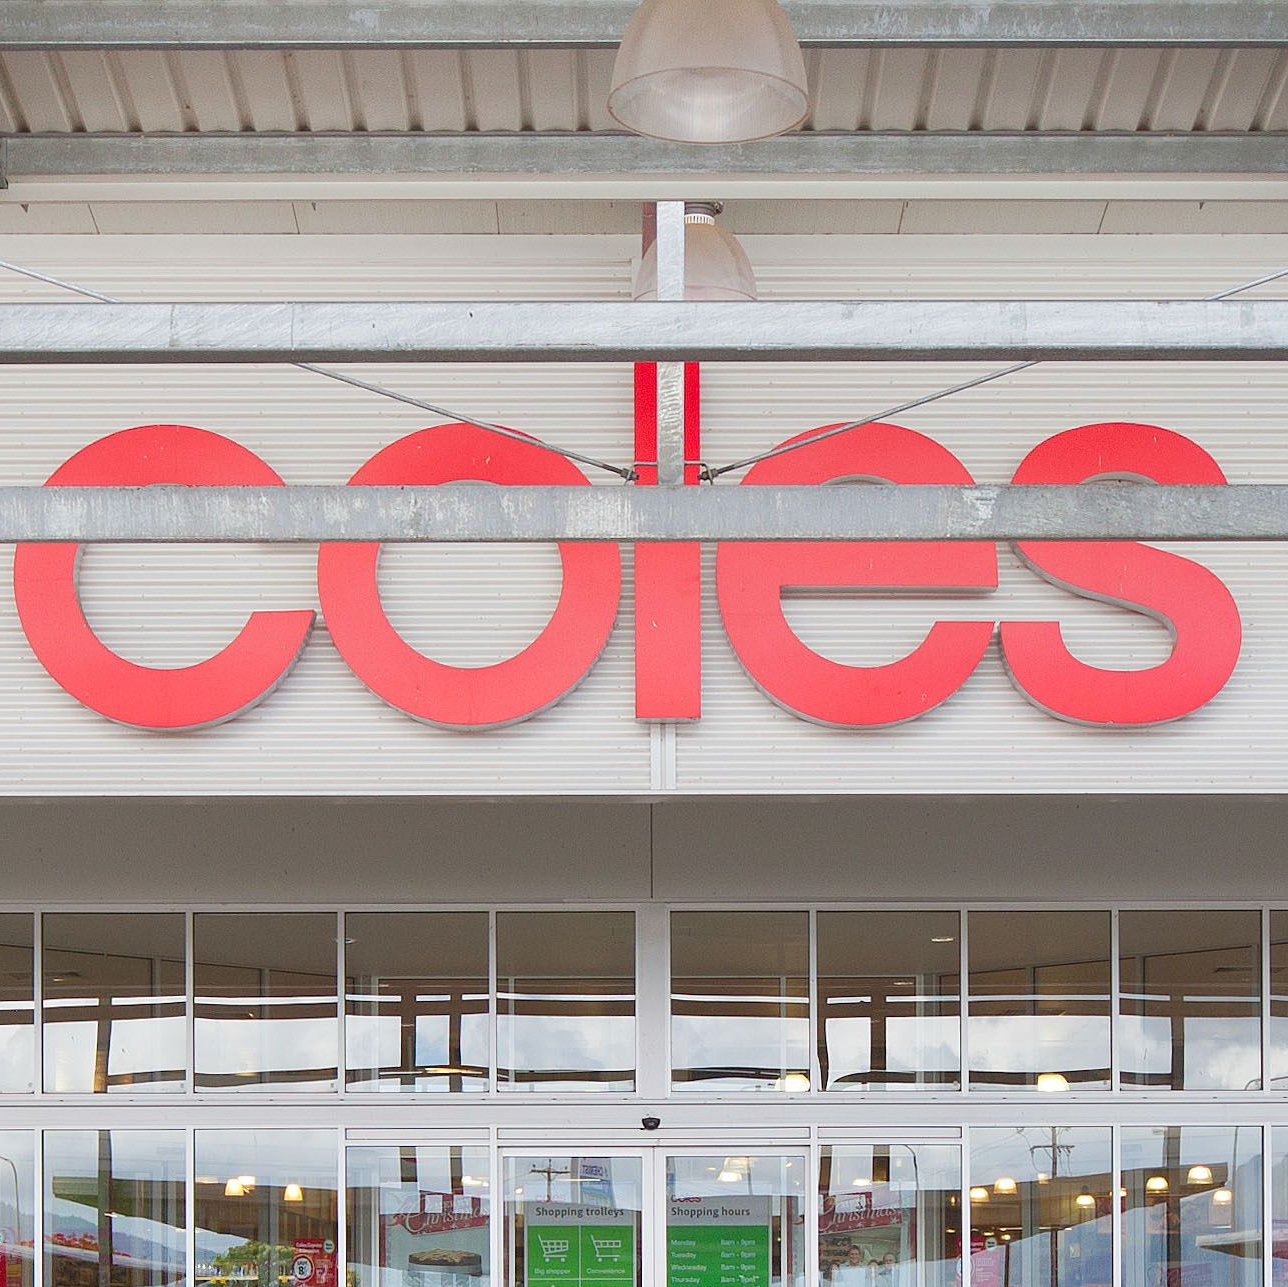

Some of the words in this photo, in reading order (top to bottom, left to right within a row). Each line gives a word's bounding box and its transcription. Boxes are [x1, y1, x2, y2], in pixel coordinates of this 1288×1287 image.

[14, 361, 1242, 732] coles
[535, 1207, 583, 1219] Shopping
[585, 1207, 625, 1219] trolleys
[671, 1207, 719, 1219] Shopping
[721, 1207, 751, 1216] hours
